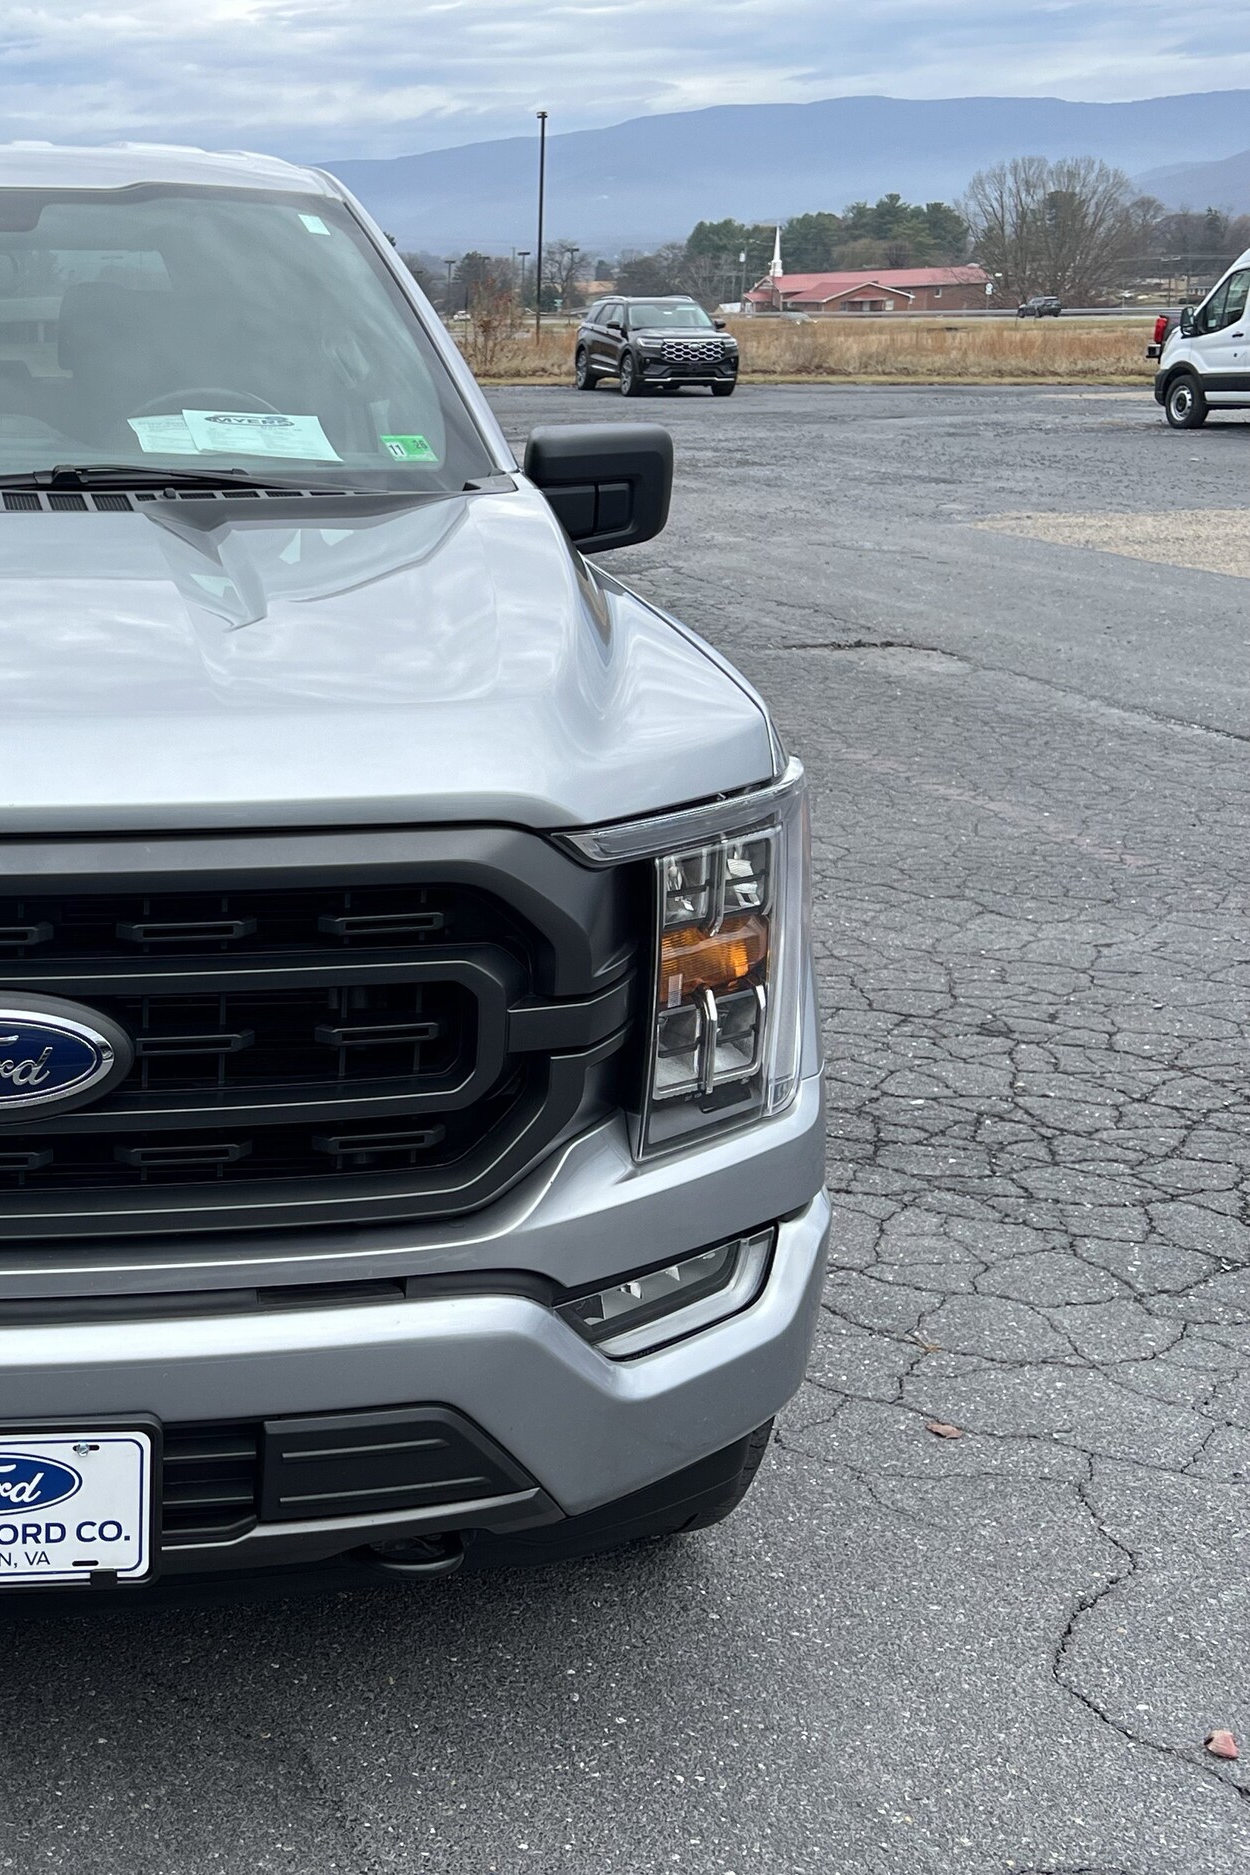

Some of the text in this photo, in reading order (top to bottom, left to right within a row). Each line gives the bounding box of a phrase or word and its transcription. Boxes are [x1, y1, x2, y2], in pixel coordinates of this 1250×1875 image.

[389, 444, 405, 455] 11
[76, 1520, 131, 1543] CO.
[24, 1551, 51, 1566] VA
